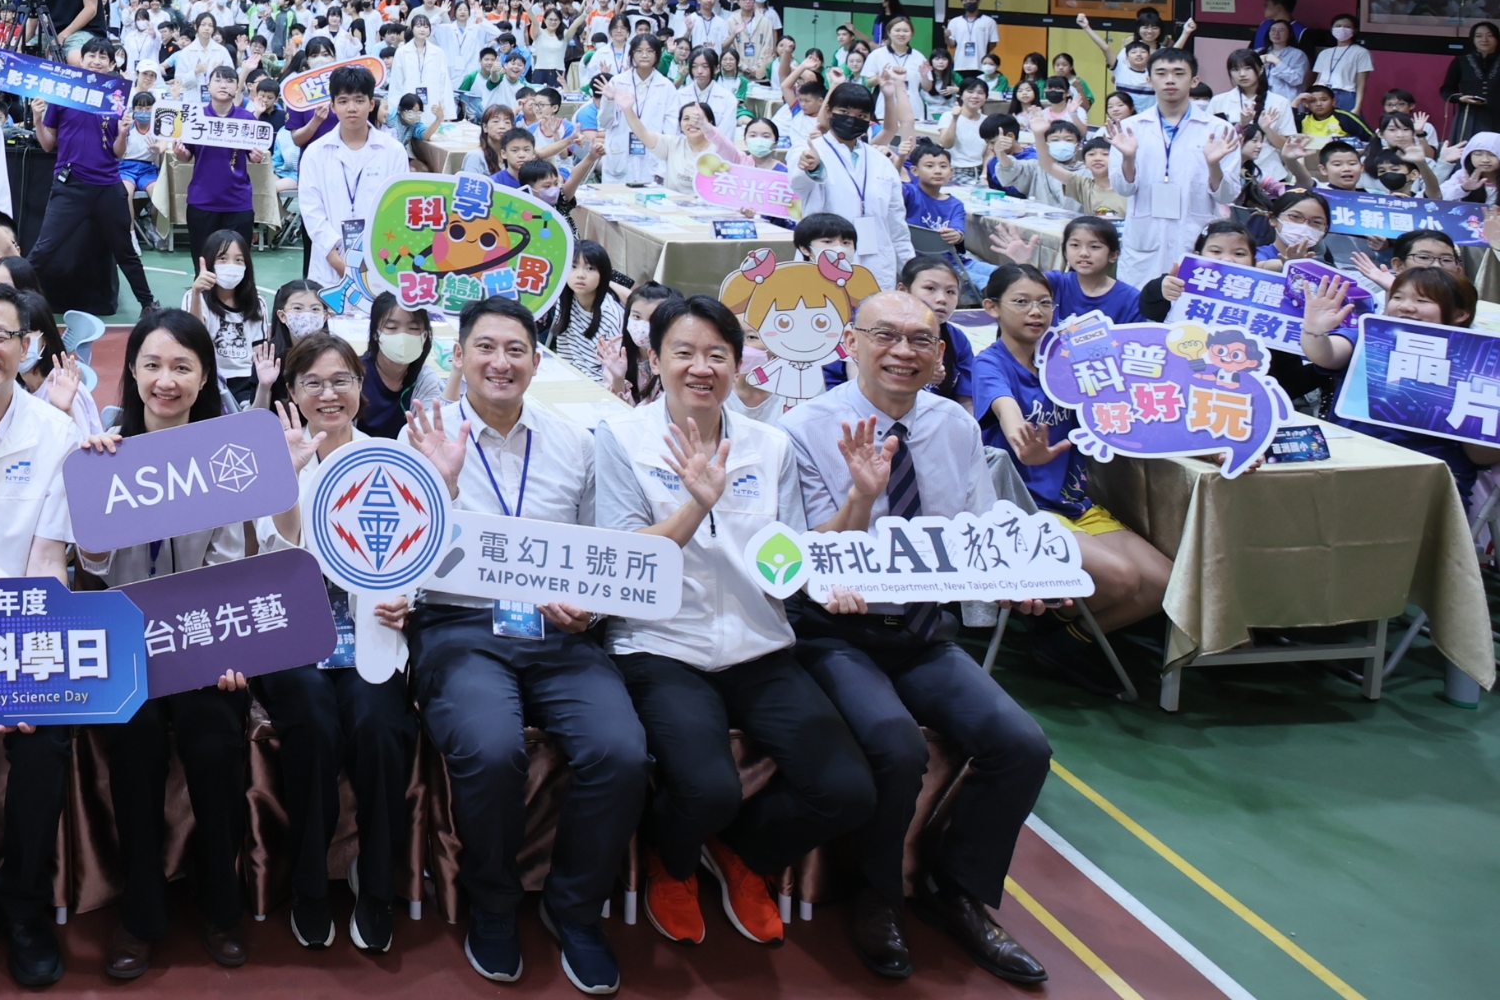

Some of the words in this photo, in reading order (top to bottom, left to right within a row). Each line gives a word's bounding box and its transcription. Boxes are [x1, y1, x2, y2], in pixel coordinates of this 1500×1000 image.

[6, 69, 105, 108] 影子傳奇劇團
[179, 103, 271, 140] 影子傳奇劇團
[407, 176, 491, 227] 科學
[712, 171, 795, 207] 奈米金
[1331, 206, 1444, 232] 北新國小
[400, 255, 549, 311] 改變世界
[1188, 266, 1286, 309] 半導體
[1073, 330, 1106, 345] SCIENCE
[1185, 299, 1304, 346] 科學教育
[1072, 341, 1167, 397] 科普
[1385, 331, 1500, 437] 晶片
[1092, 381, 1252, 441] 好好玩
[104, 455, 210, 514] ASM
[732, 488, 760, 496] NTPC
[479, 530, 658, 584] 電幻1號所
[477, 567, 570, 593] TAIPOWER
[577, 581, 612, 598] D/S
[621, 586, 657, 605] ONE
[881, 583, 943, 592] Department,
[943, 581, 966, 591] New
[968, 580, 996, 591] Taipei
[998, 580, 1019, 591] City
[1021, 578, 1083, 589] Government
[144, 593, 289, 658] 台灣先藝
[12, 691, 60, 704] Science
[65, 690, 89, 704] Day
